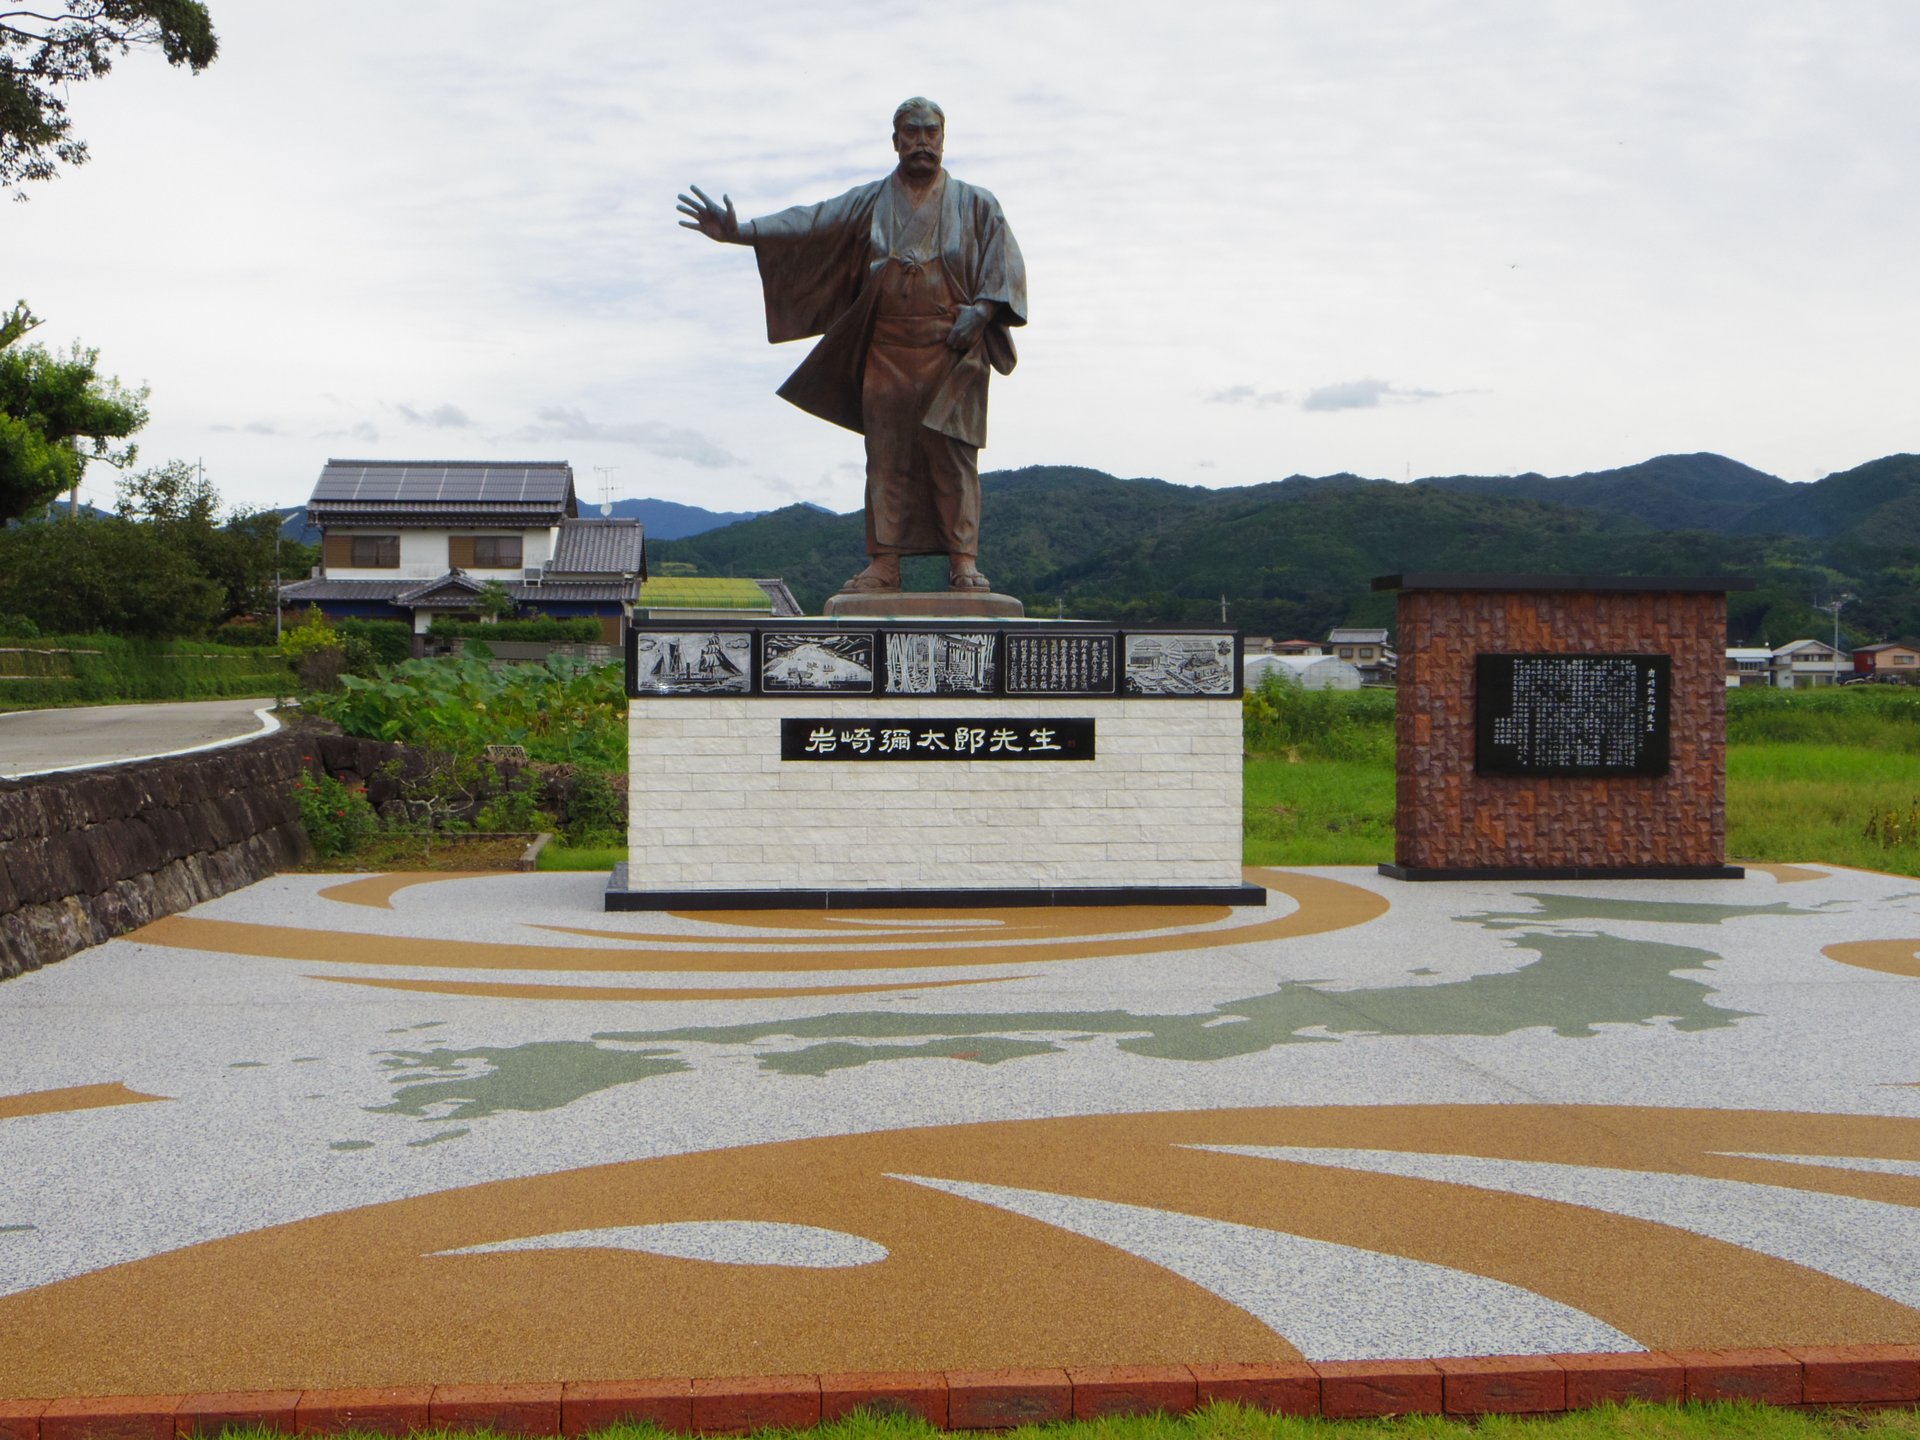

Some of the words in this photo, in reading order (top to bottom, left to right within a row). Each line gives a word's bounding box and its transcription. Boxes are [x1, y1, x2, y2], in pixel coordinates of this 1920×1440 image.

[805, 726, 1062, 754] 岩崎彌太郎先生
